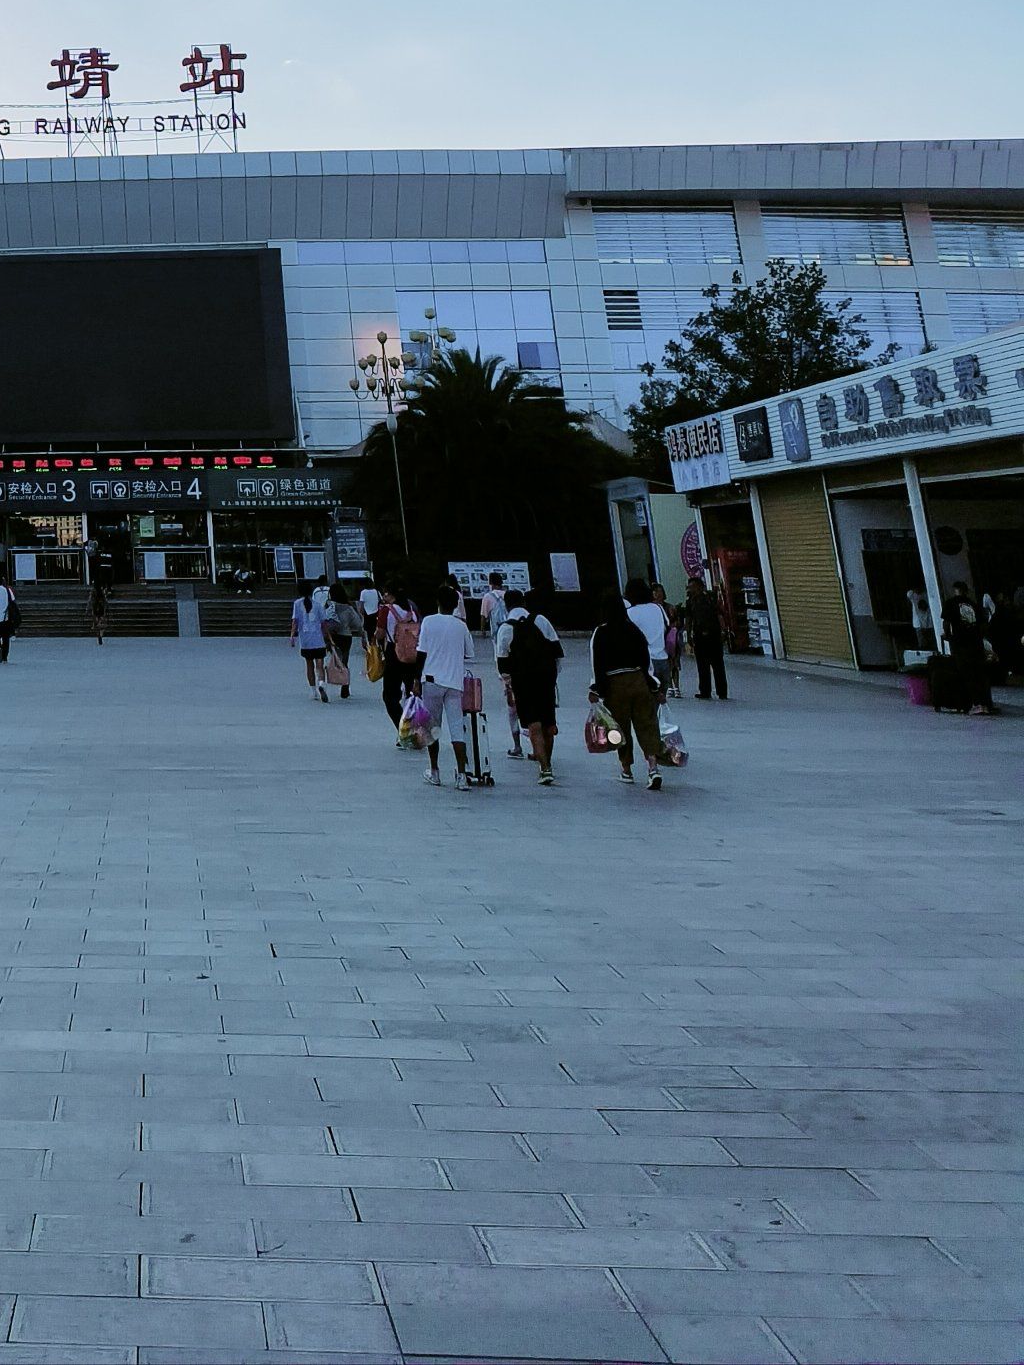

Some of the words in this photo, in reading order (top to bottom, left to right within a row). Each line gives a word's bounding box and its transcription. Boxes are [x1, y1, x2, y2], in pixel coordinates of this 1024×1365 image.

[35, 115, 130, 135] RAILWAY
[153, 112, 246, 133] STATION
[816, 354, 1024, 431] 自助售取票
[8, 481, 57, 495] 安检入口
[61, 479, 76, 502] 3
[132, 480, 182, 494] 安检入口
[186, 477, 202, 500] 4
[279, 478, 332, 491] 绿色通道
